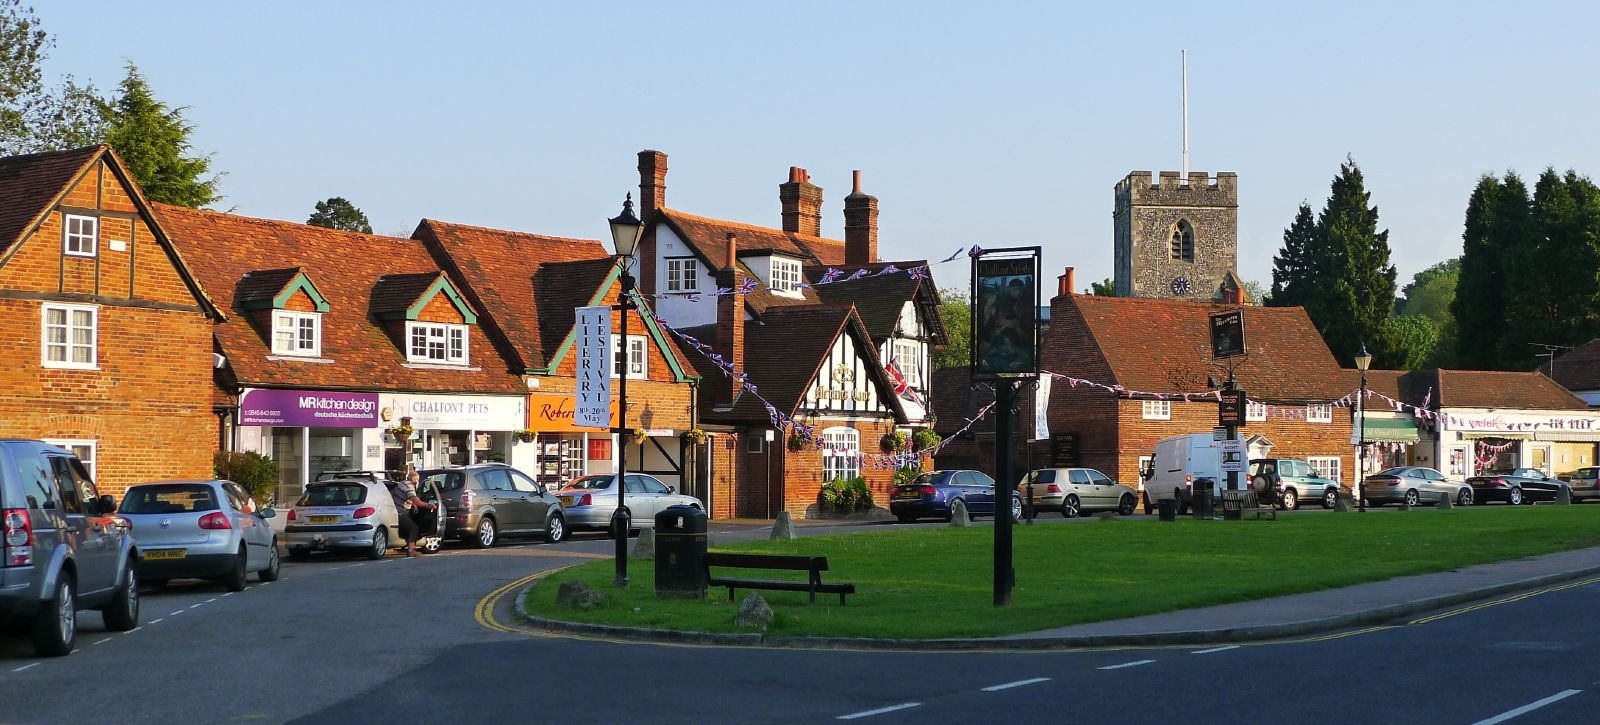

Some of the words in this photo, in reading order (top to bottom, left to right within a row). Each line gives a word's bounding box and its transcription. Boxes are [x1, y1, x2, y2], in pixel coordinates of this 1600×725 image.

[581, 315, 591, 402] LITERARY
[596, 315, 606, 402] FESTIVAL
[347, 398, 376, 412] design
[412, 401, 465, 414] CHALFONT
[468, 403, 489, 414] PETS
[583, 414, 601, 423] May
